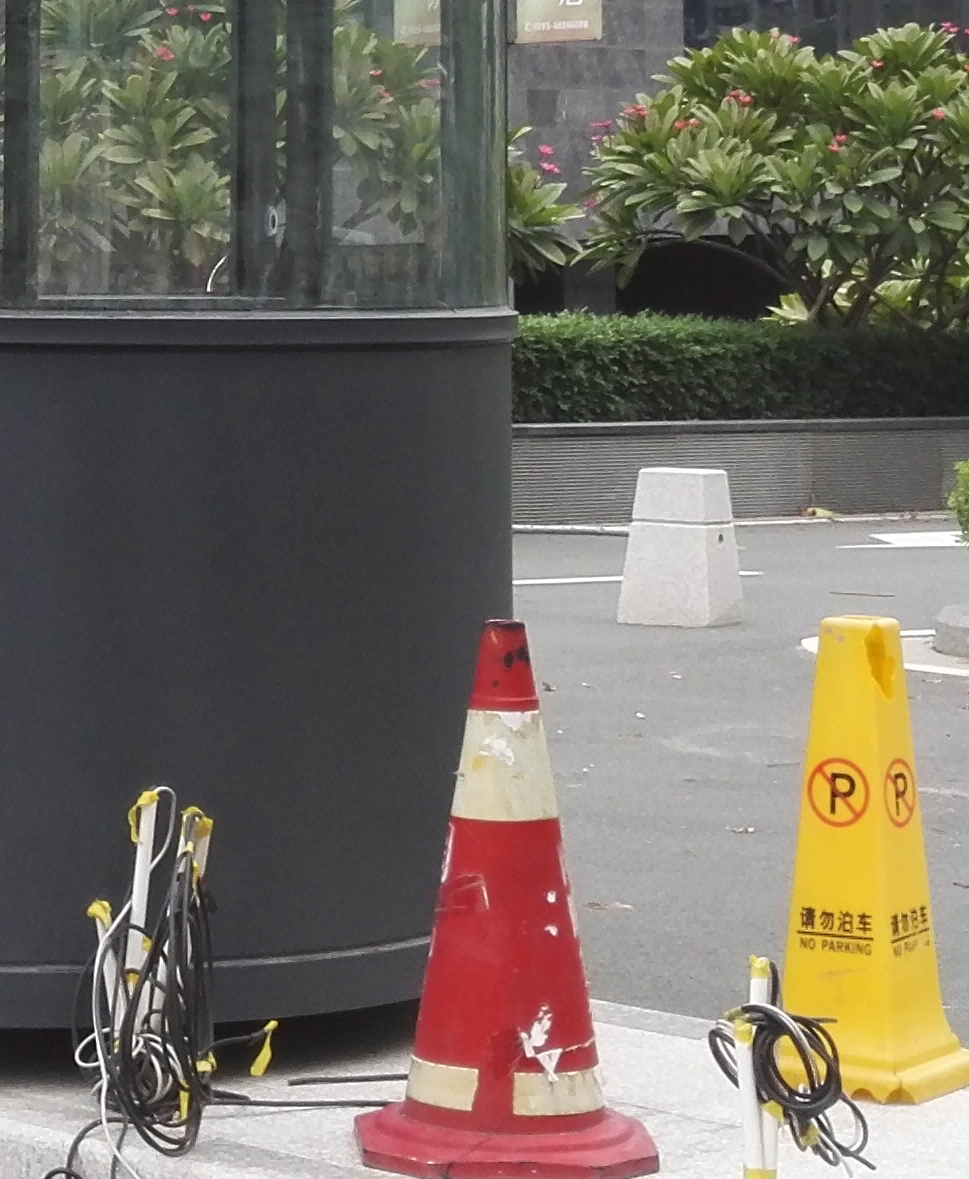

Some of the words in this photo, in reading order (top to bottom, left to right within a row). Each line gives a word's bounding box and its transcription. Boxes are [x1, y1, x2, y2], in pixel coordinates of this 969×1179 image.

[829, 771, 856, 815] P
[799, 906, 873, 935] 请勿泊车
[890, 905, 928, 936] 请勿泊车
[799, 938, 816, 950] NO
[821, 939, 873, 956] PARKING
